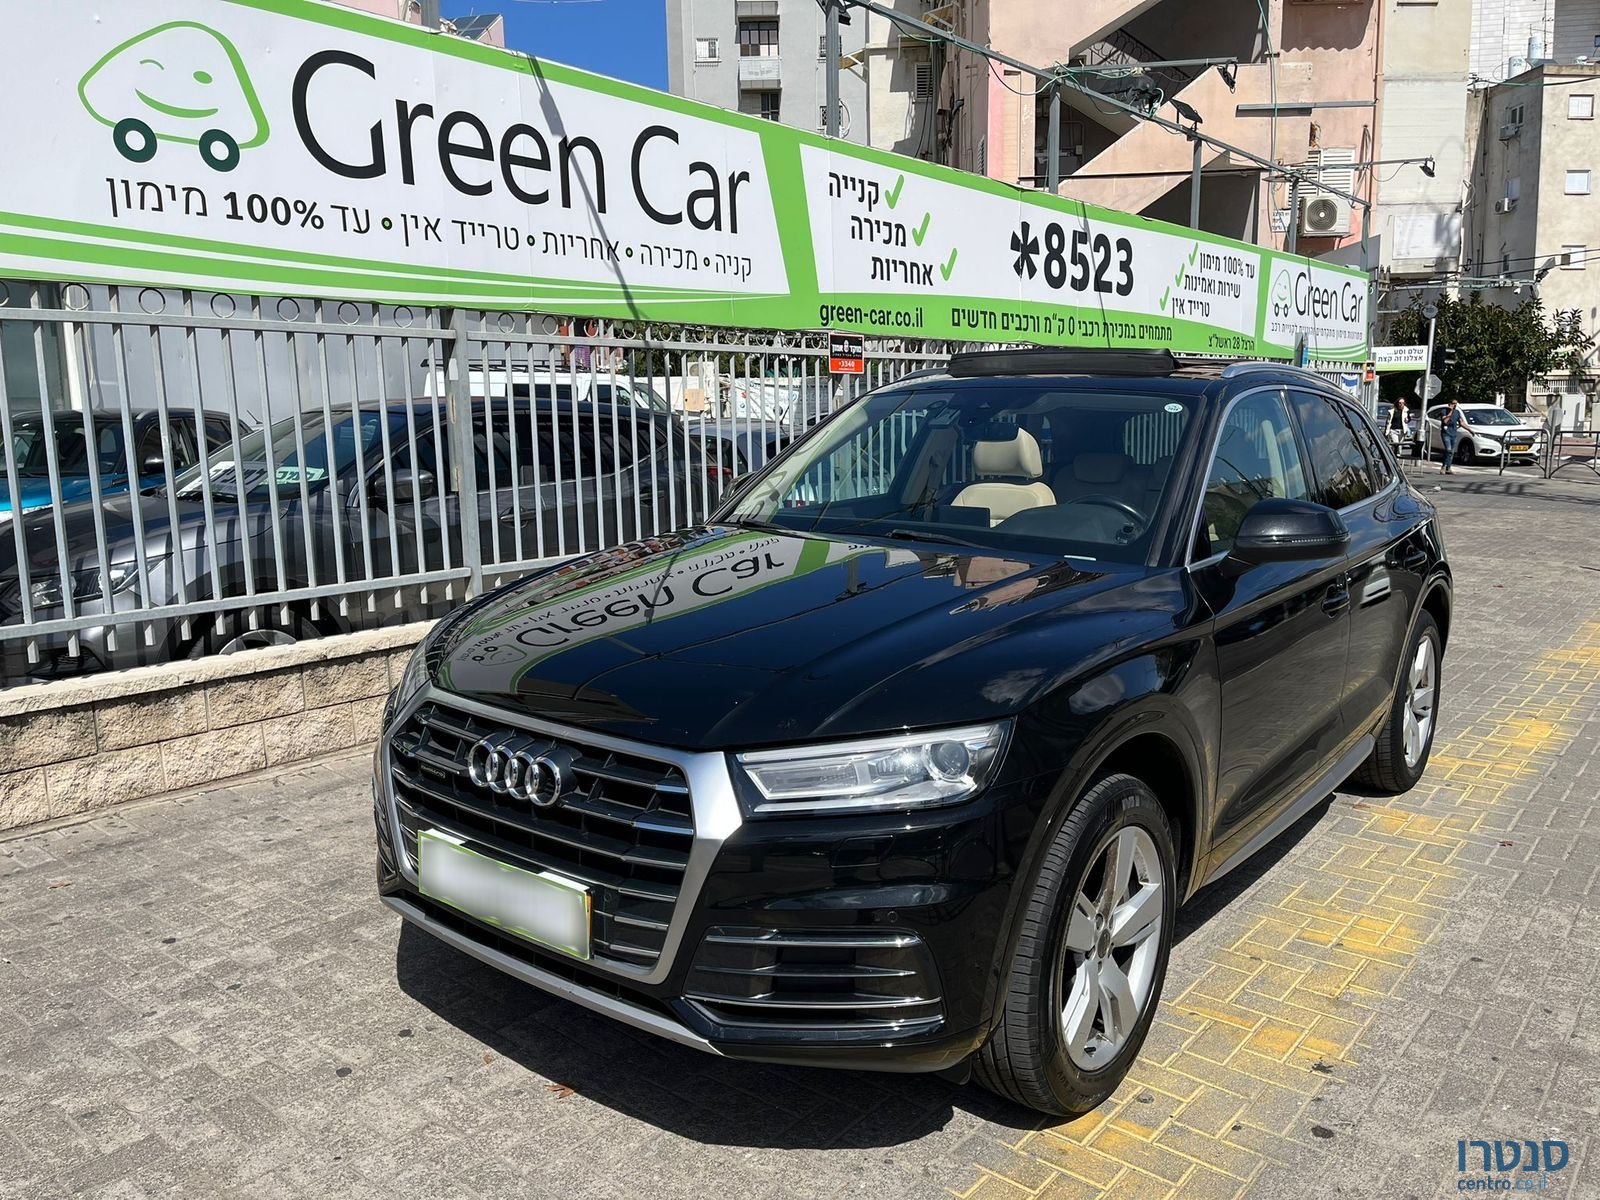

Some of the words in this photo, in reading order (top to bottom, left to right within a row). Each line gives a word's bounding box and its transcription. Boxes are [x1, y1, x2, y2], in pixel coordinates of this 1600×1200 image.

[292, 50, 607, 214] Green
[630, 125, 750, 234] Car
[105, 177, 208, 218] מימון
[829, 171, 879, 212] קנייה
[223, 191, 325, 230] 100%
[330, 204, 370, 234] עד
[400, 213, 442, 247] אין
[451, 219, 519, 250] טרייד
[851, 215, 906, 247] מכירה
[542, 231, 620, 262] אחריות
[641, 243, 698, 270] מכירה
[715, 254, 751, 282] קניה
[871, 256, 933, 286] אחריות
[1200, 252, 1221, 273] מימון
[1223, 256, 1243, 276] 100%
[1245, 263, 1255, 279] עד
[1184, 274, 1215, 294] ואמינות
[1217, 280, 1240, 298] שירות
[1172, 297, 1185, 318] אין
[1188, 300, 1210, 317] טרייד
[1295, 272, 1338, 320] Green
[1342, 281, 1363, 323] Car
[820, 304, 923, 328] green-car.co.il
[952, 308, 997, 329] חדשים
[1001, 312, 1040, 333] ורכבים
[1068, 316, 1075, 336] 0
[1078, 320, 1100, 337] רכבי
[1103, 321, 1136, 339] במכירת
[1139, 324, 1172, 341] מתמחים
